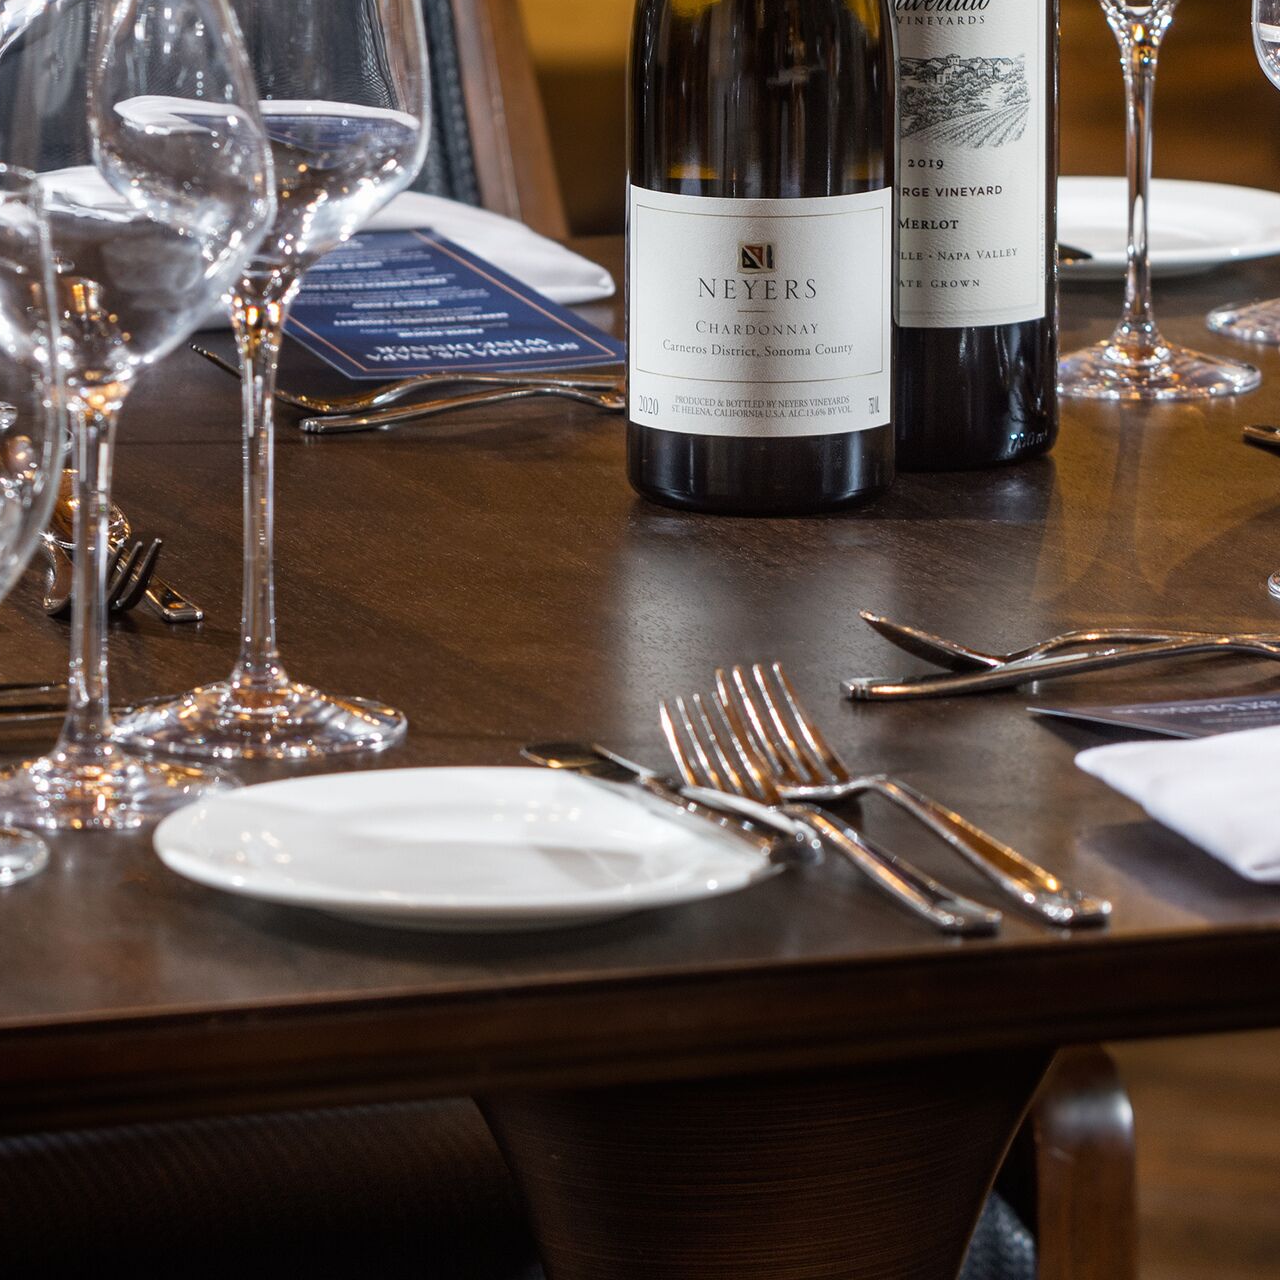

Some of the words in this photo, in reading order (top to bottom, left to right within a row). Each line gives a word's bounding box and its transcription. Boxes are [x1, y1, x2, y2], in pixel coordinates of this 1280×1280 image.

[897, 15, 985, 26] VINEYARDS
[907, 159, 944, 170] 2019
[901, 186, 930, 198] RGE
[935, 185, 1003, 198] VINEYARD
[898, 217, 959, 230] MERLOT
[900, 251, 924, 261] LLE
[937, 251, 970, 261] NAPA
[976, 247, 1018, 259] VALLEY
[698, 277, 817, 300] NEYERS
[897, 279, 923, 288] ATE
[930, 279, 980, 289] GROWN
[695, 320, 819, 336] CHARDONNAY
[374, 342, 476, 354] DINNER
[471, 342, 580, 358] SONOMA
[662, 339, 708, 355] Carneros
[711, 343, 760, 358] District,
[763, 345, 811, 358] Sonoma
[815, 342, 854, 356] County
[364, 352, 432, 362] NAPA
[639, 394, 659, 416] 2020
[674, 395, 716, 407] PRODUCED
[718, 399, 725, 408] &
[726, 399, 765, 409] BOTTLED
[766, 399, 777, 409] BY
[778, 399, 808, 409] NEYERS
[809, 395, 850, 408] VINEYARDS
[714, 407, 765, 418] CALIFORNIA
[827, 405, 838, 416] BY
